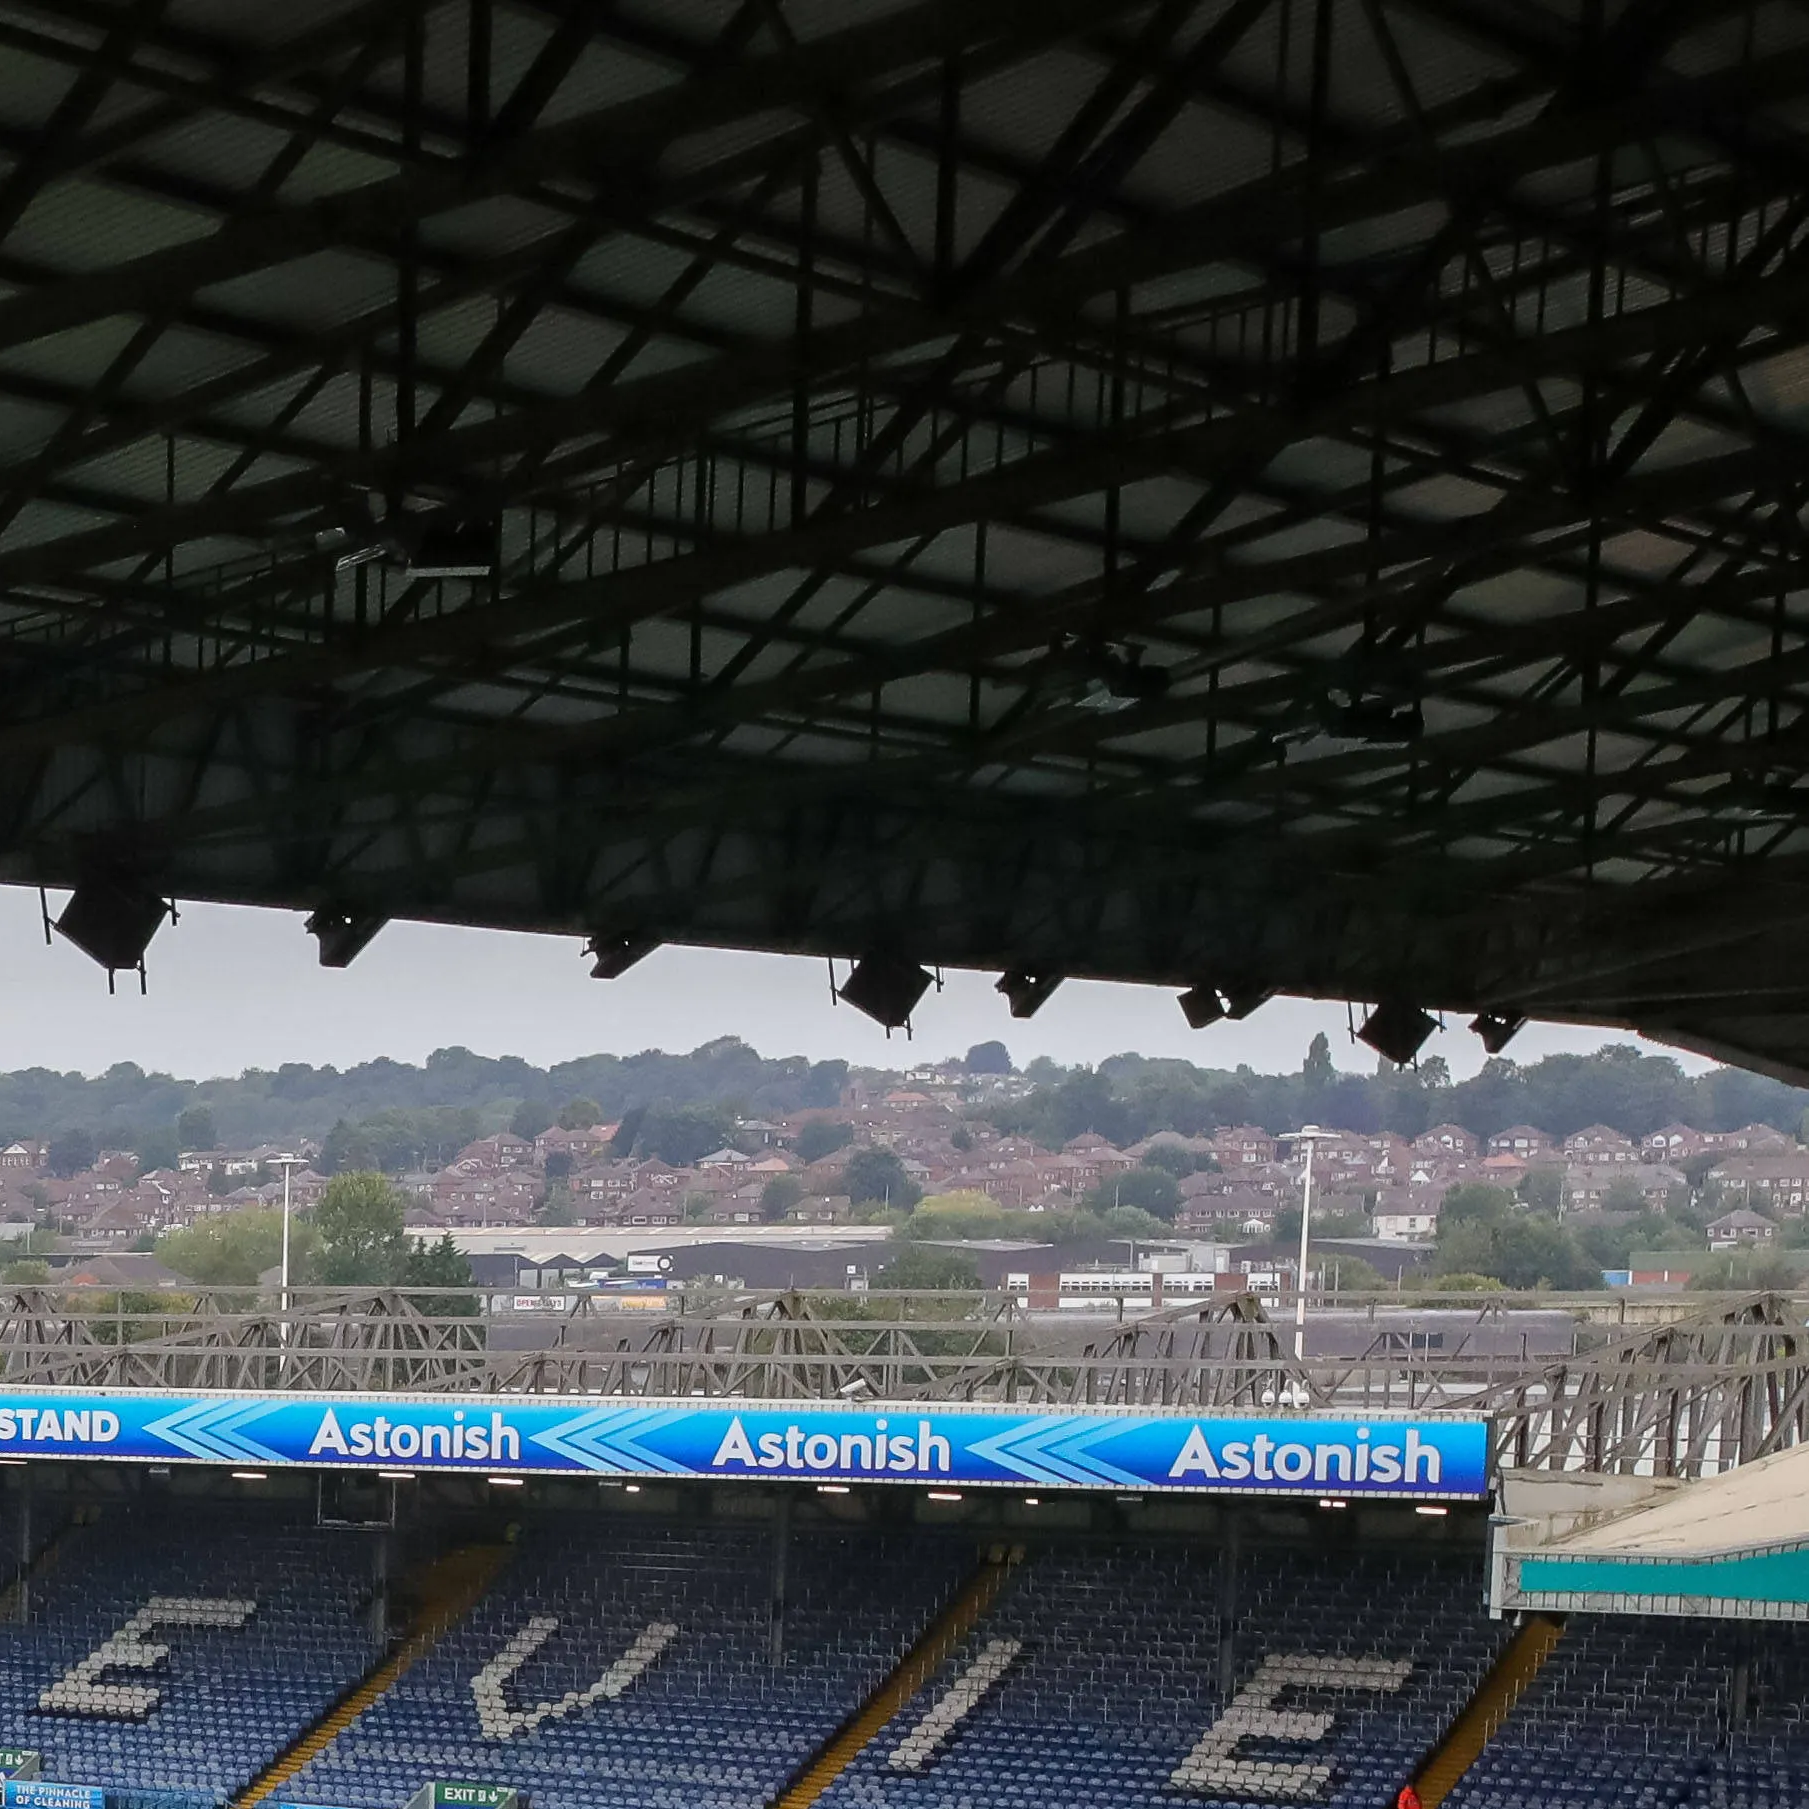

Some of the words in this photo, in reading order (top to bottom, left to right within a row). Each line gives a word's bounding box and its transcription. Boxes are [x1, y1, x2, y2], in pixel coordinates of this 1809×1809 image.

[309, 1405, 523, 1459] Astonish
[712, 1416, 949, 1471] Astonish
[1169, 1425, 1440, 1483] Astonish
[16, 1785, 34, 1794] THE
[36, 1786, 92, 1800] PINNACLE
[16, 1795, 30, 1804] OF
[34, 1795, 91, 1809] CLEANING
[445, 1788, 473, 1801] EXIT
